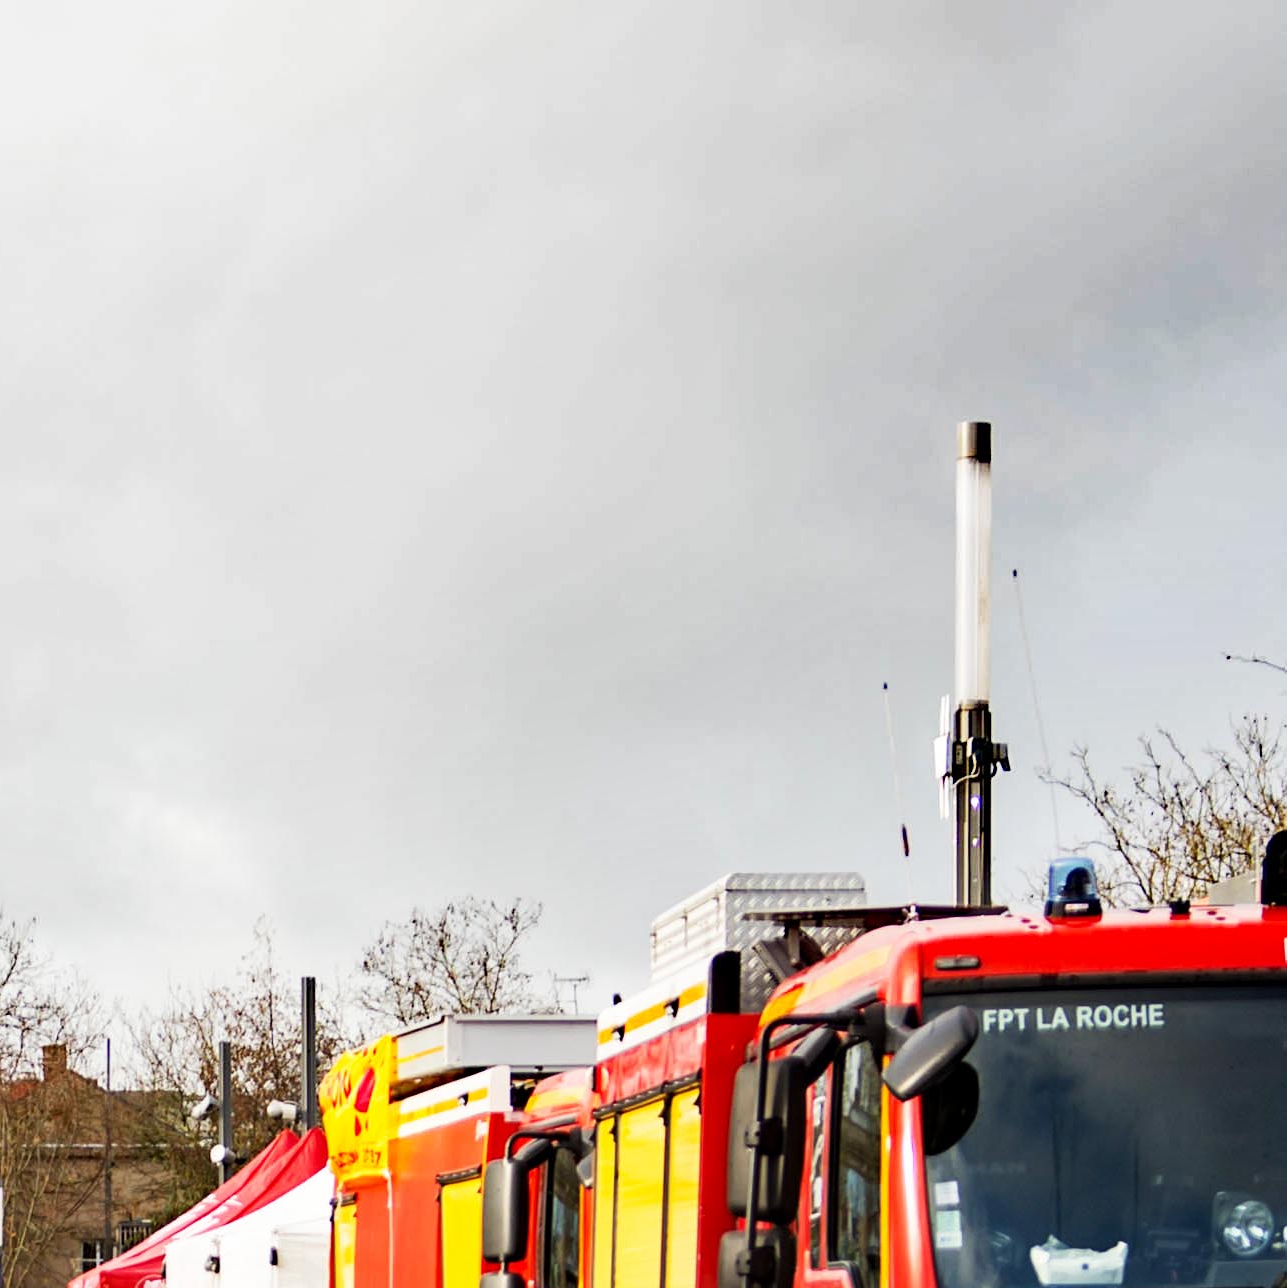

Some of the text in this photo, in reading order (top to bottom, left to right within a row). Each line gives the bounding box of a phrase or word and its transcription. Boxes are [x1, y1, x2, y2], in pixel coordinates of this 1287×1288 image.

[983, 1004, 1165, 1032] FPT LA ROCHE
